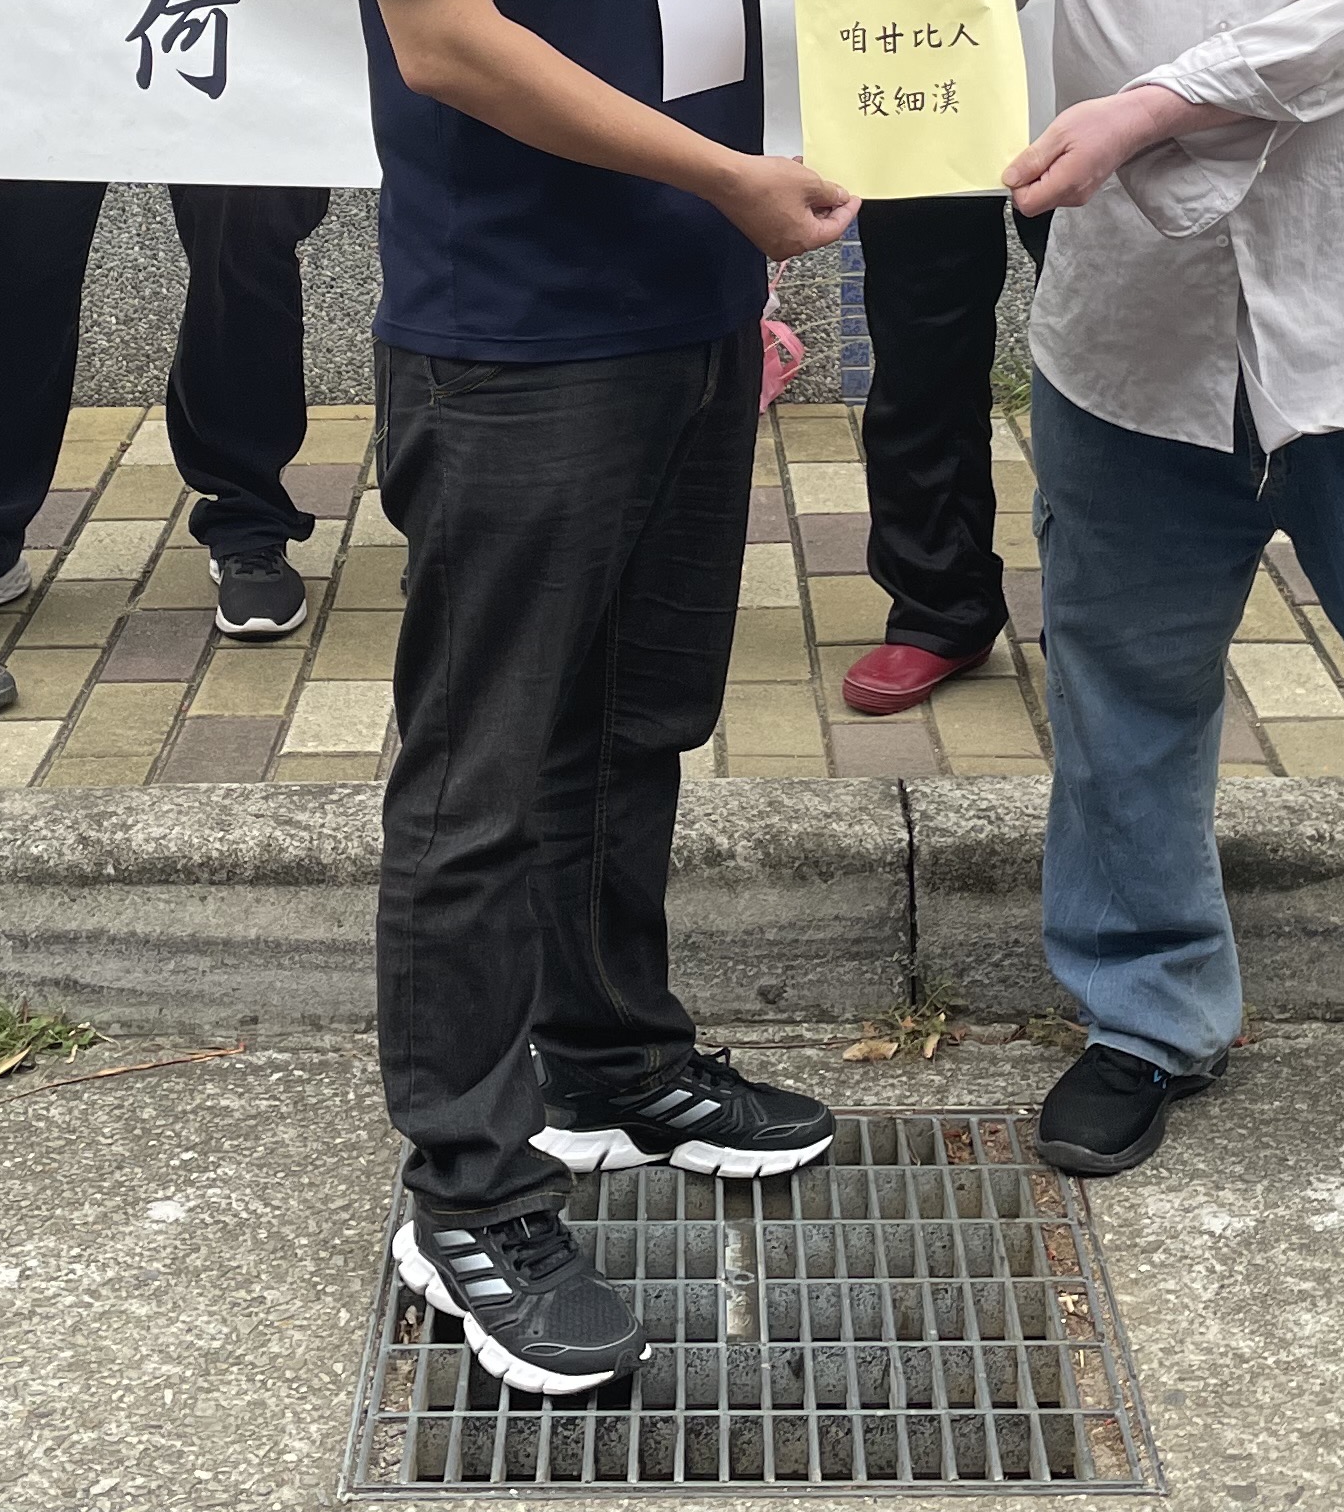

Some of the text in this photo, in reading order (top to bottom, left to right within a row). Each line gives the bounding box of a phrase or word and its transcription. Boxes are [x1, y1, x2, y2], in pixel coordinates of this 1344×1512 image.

[839, 21, 980, 54] 咱甘比人
[857, 79, 959, 117] 較細漢
